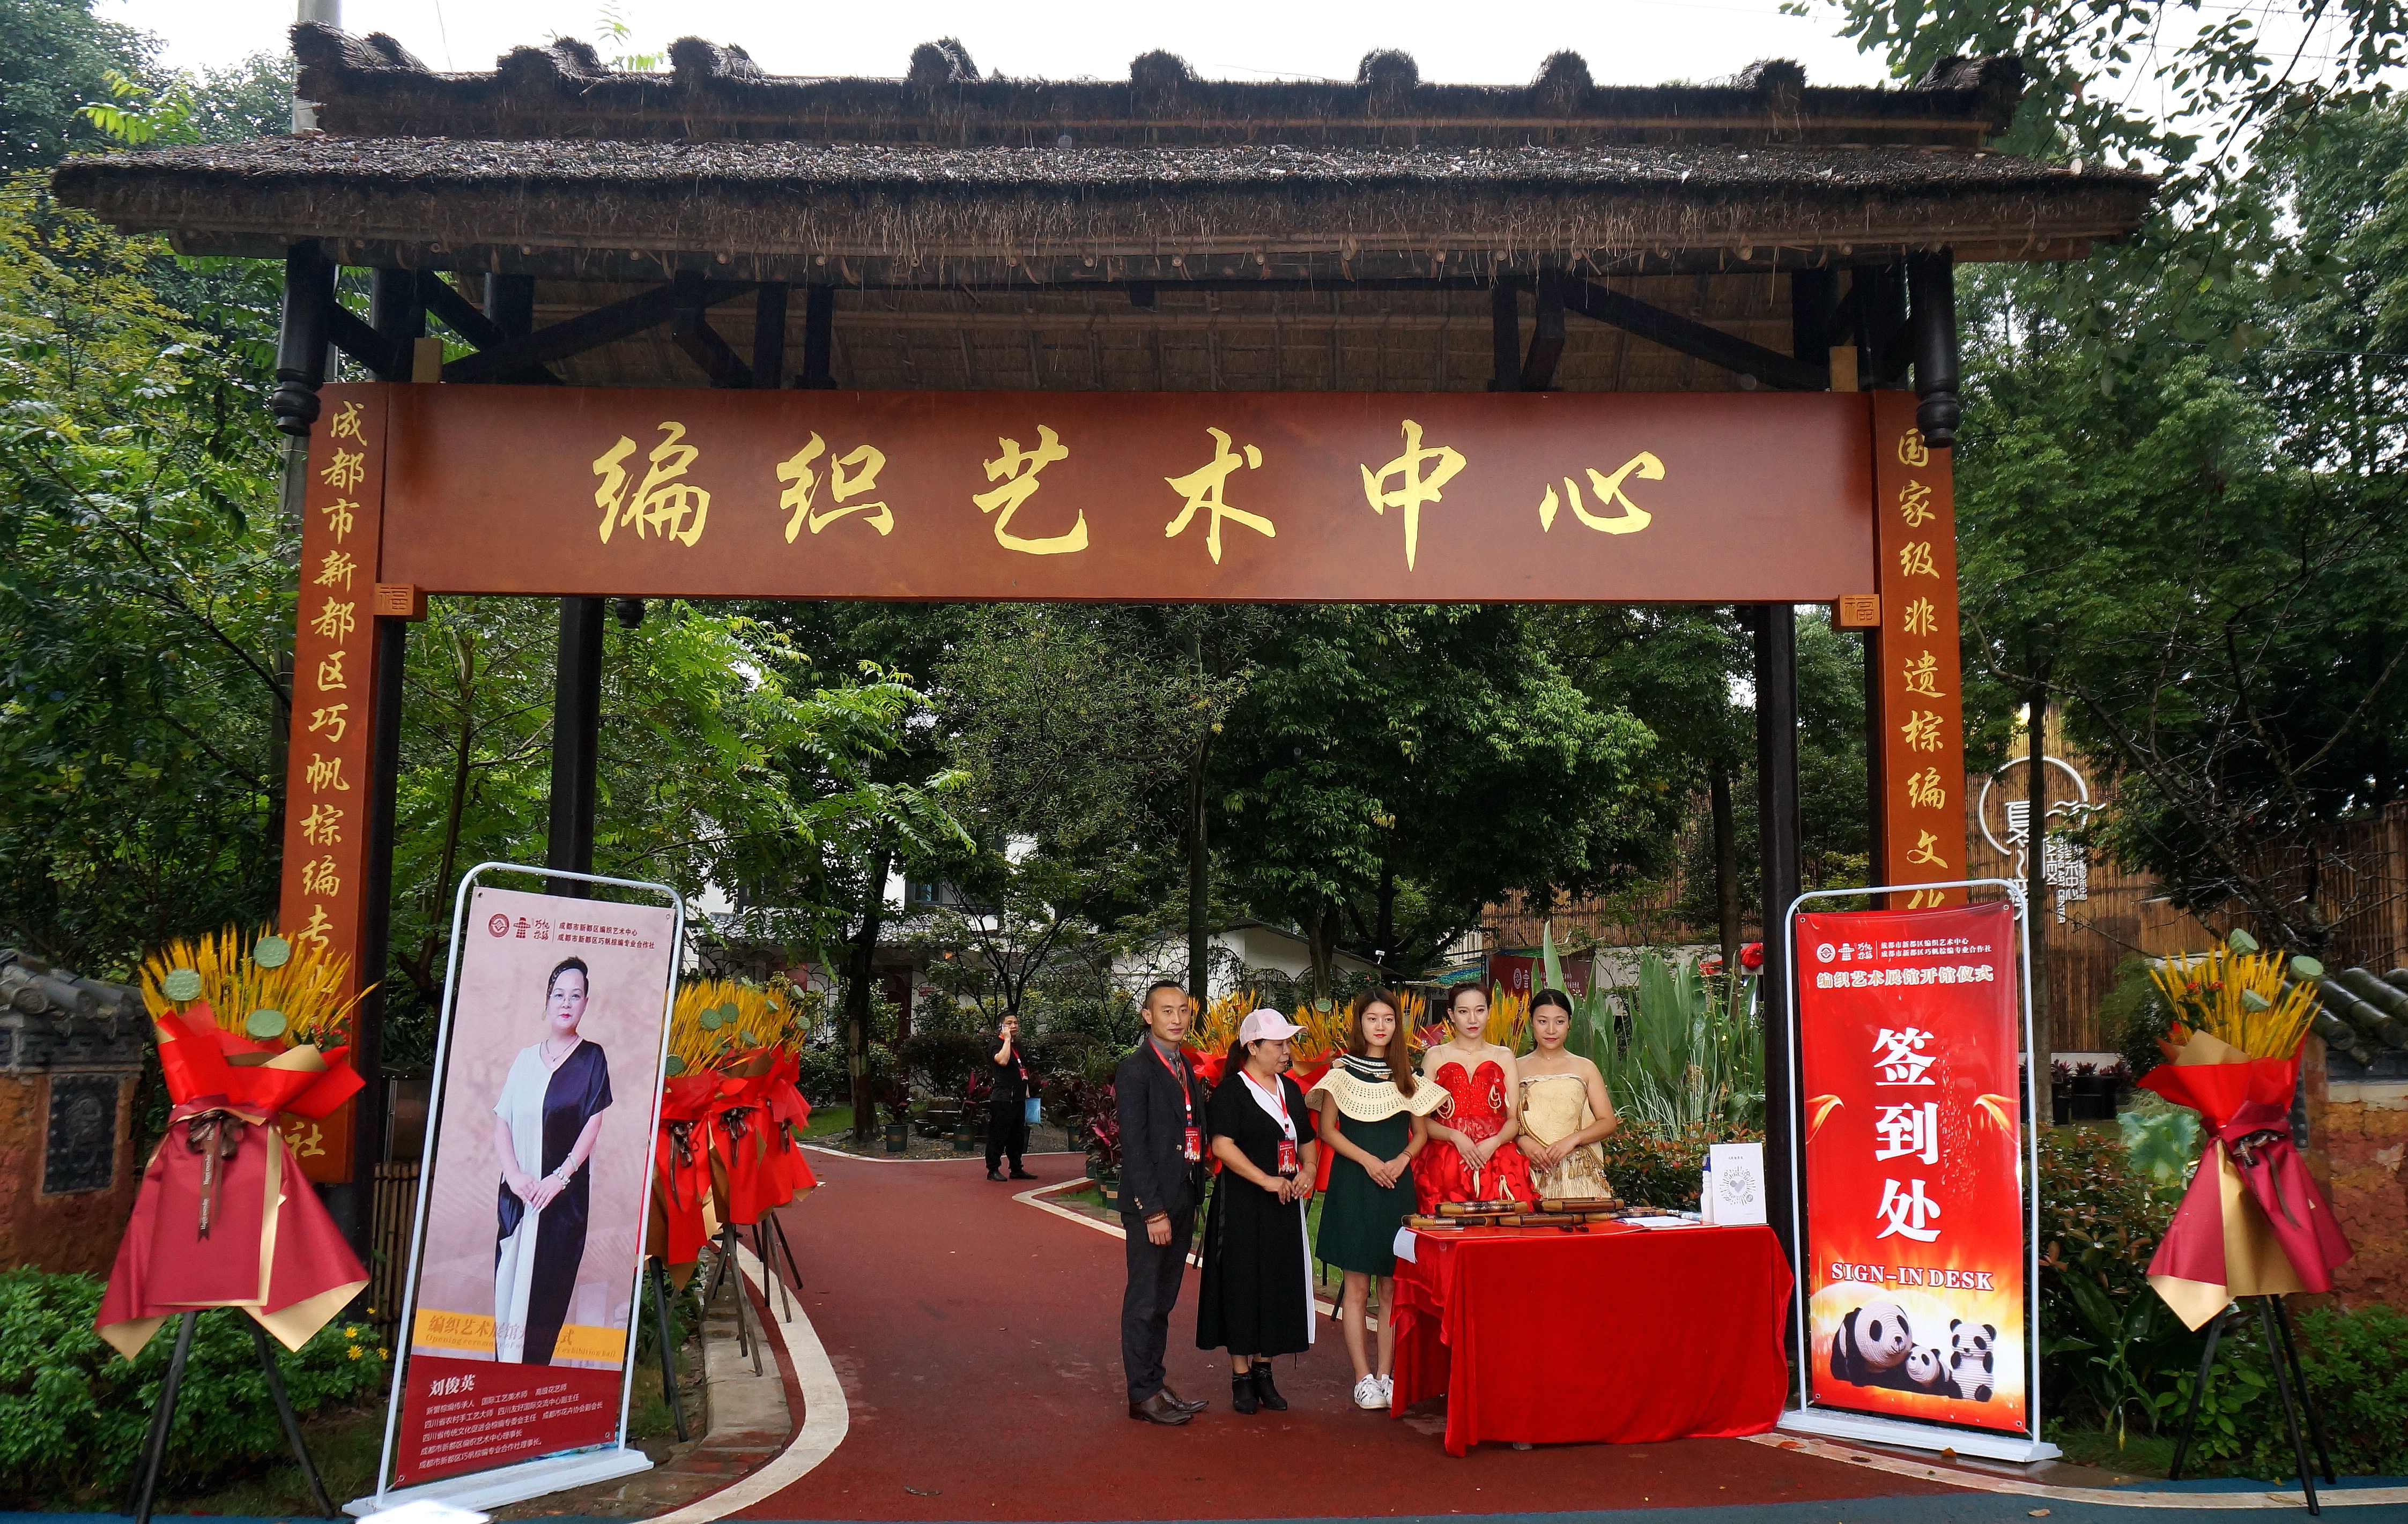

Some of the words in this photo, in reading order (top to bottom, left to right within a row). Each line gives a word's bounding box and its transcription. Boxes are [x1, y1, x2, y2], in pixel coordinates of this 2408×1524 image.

[592, 419, 1666, 572] 编织艺术中心
[1844, 597, 1875, 623] 福
[285, 400, 367, 1158] 成都市新都区巧帆棕编专社
[2057, 835, 2065, 868] EAVING
[557, 933, 655, 949] 成都市新都区巧帆棕编专业合作社
[559, 921, 638, 936] 成都市新都区编织艺术中心
[1880, 938, 1969, 949] 成都市新都区编织艺术中心
[1880, 945, 1992, 958] 成都市新都区巧帆棕编专业合作社
[1817, 964, 1995, 988] 编织艺术展馆开馆仪式
[1871, 1026, 1942, 1243] 签到处
[1831, 1262, 1923, 1285] SIGN-IN
[1929, 1269, 1994, 1290] DESK
[428, 1373, 476, 1397] 刘俊英
[424, 1408, 494, 1430] 四川省农村手工艺大师
[420, 1428, 523, 1456] 成都市新都区编织艺术中心理事长
